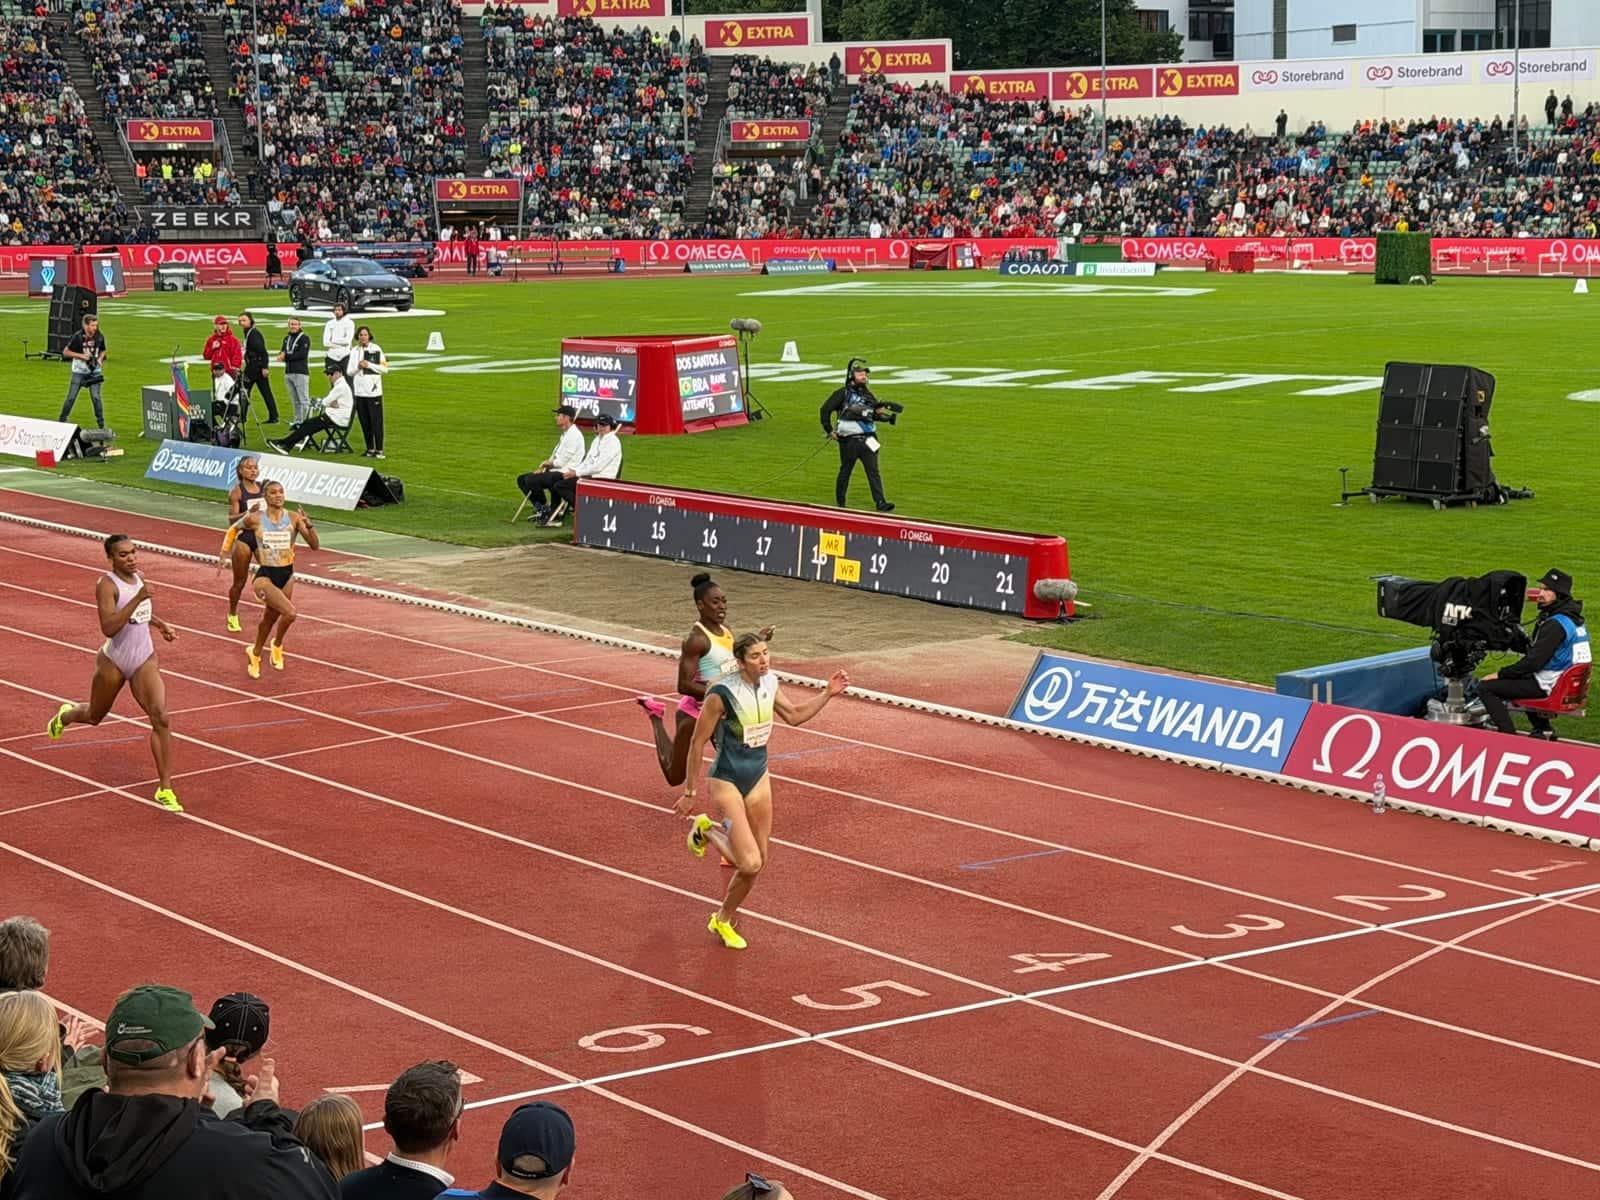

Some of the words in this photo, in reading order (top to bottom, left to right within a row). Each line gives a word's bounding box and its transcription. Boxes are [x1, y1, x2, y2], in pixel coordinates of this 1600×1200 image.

[601, 0, 651, 9] EXTRA
[747, 26, 795, 39] EXTRA
[885, 52, 932, 66] EXTRA
[1519, 60, 1587, 74] Storebrand
[1281, 70, 1344, 83] Storebrand
[1397, 65, 1463, 78] Storebrand
[989, 80, 1036, 94] EXTRA
[1091, 77, 1139, 91] EXTRA
[1186, 74, 1235, 88] EXTRA
[162, 126, 201, 136] EXTRA
[762, 126, 799, 136] EXTRA
[470, 185, 508, 195] EXTRA
[151, 212, 252, 226] ZEEKR
[172, 248, 248, 264] OMEGA
[675, 244, 746, 260] OMEGA
[1124, 242, 1207, 259] OMEGA
[1008, 263, 1068, 275] COAST
[562, 354, 580, 368] DOS
[580, 355, 613, 370] SANTOS
[613, 358, 622, 370] A
[676, 356, 691, 370] DOS
[691, 353, 719, 368] SANTOS
[718, 352, 727, 365] A
[577, 377, 597, 393] BRA
[598, 378, 619, 390] RANK
[628, 380, 636, 397] 7
[691, 377, 710, 393] BRA
[710, 372, 727, 385] RANK
[732, 370, 739, 387] 7
[730, 394, 738, 410] X
[147, 409, 168, 423] BISLETT
[620, 402, 629, 419] X
[303, 472, 364, 500] LEAGUE
[656, 496, 676, 506] OMEGA
[602, 513, 617, 533] 14
[651, 521, 666, 540] 15
[702, 528, 718, 548] 16
[908, 530, 934, 543] OMEGA
[755, 536, 772, 556] 17
[826, 539, 839, 552] MR
[840, 563, 854, 577] WR
[869, 553, 888, 575] 19
[931, 562, 950, 585] 20
[995, 571, 1014, 595] 21
[1332, 883, 1447, 912] 2
[1169, 913, 1285, 940] 3
[1008, 952, 1113, 974] 4
[791, 979, 932, 1010] 5
[577, 1023, 713, 1053] 6
